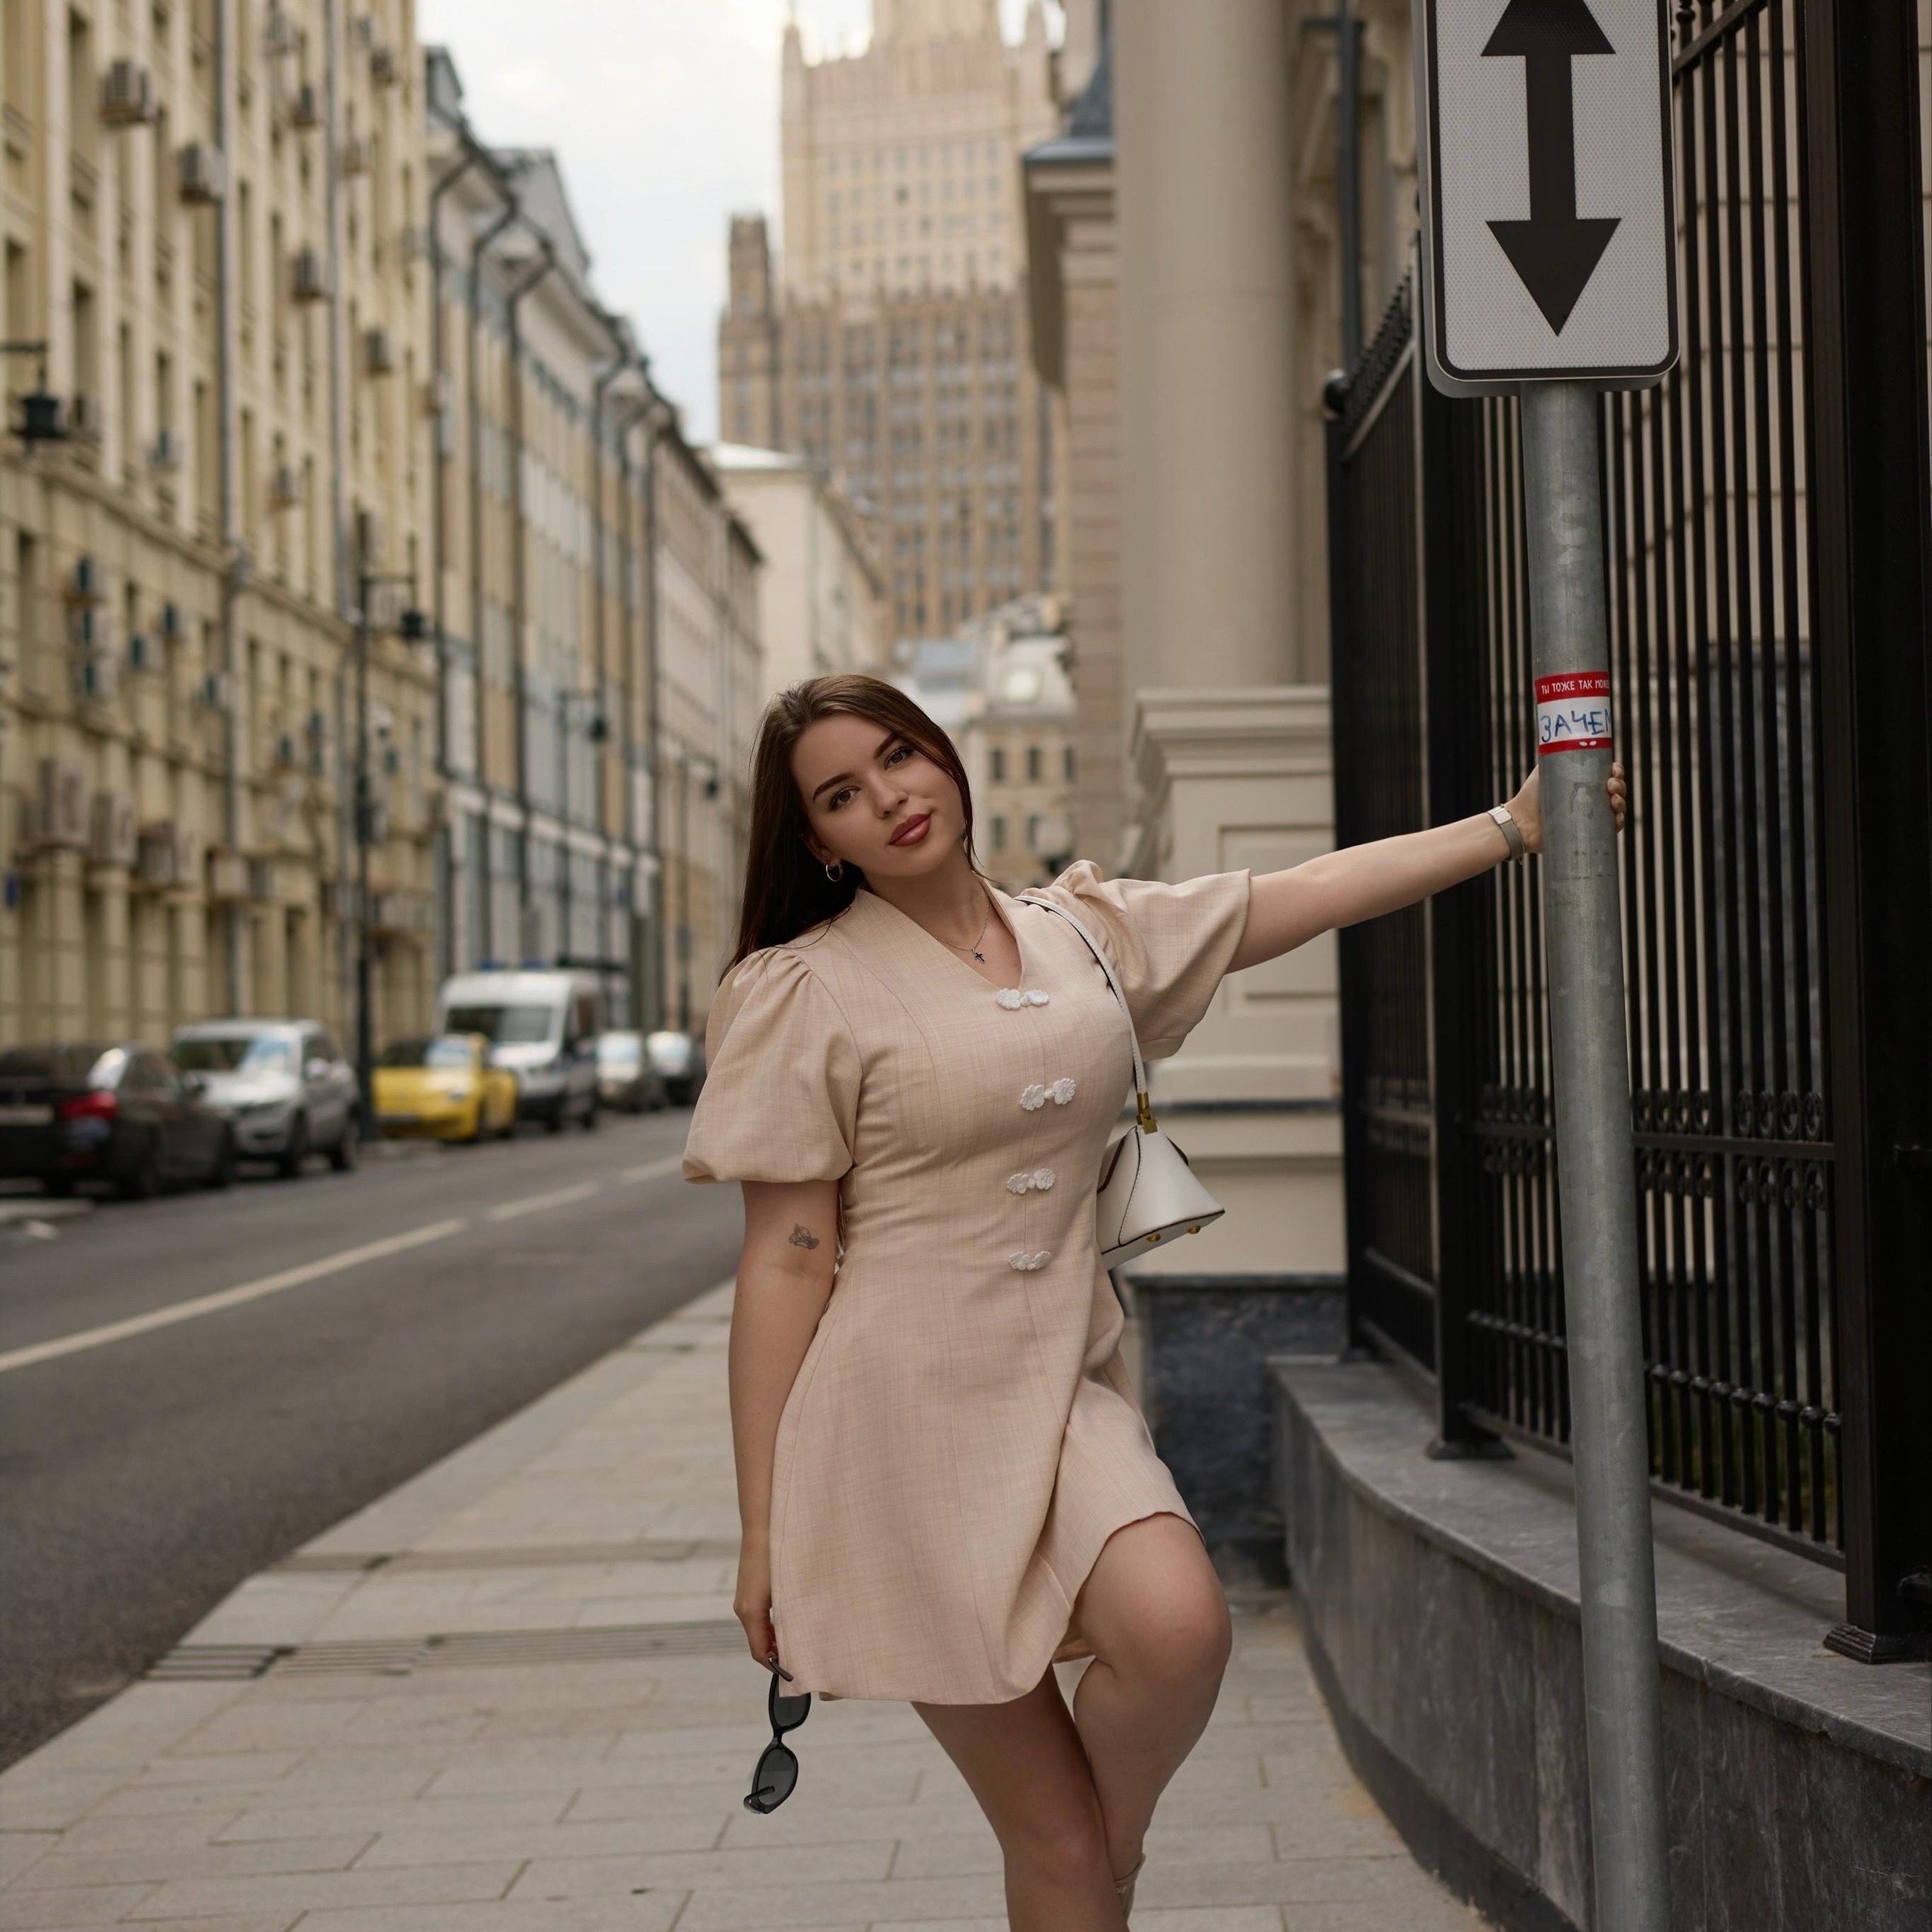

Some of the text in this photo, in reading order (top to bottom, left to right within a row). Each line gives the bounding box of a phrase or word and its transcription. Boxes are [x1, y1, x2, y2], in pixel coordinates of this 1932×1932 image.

[1541, 685, 1549, 694] ТЫ
[1552, 681, 1575, 692] ТОЖЕ
[1578, 679, 1593, 690] ТАК
